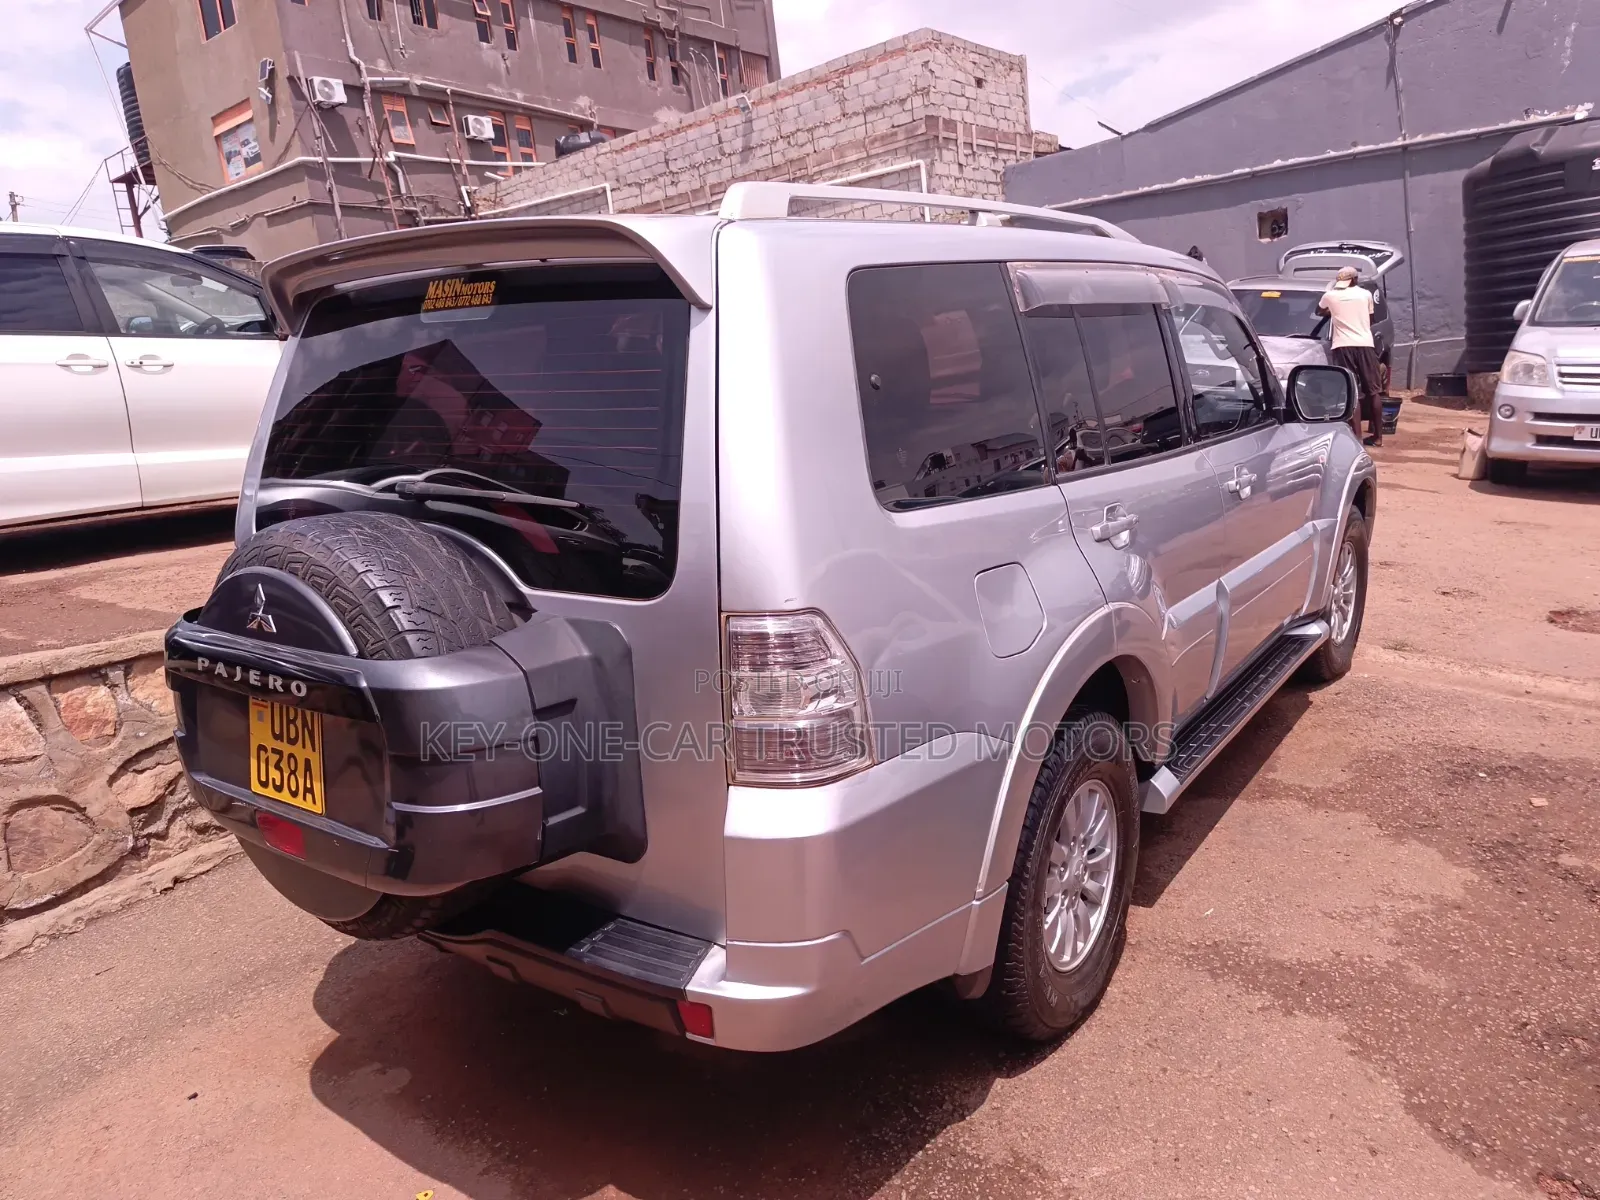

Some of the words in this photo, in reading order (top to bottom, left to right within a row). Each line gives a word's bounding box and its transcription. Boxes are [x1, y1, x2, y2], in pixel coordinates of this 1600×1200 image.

[425, 278, 463, 299] MASIN
[461, 281, 496, 295] MOTORS
[197, 656, 308, 697] PAJERO
[270, 701, 316, 753] UBN
[256, 743, 317, 806] 038A
